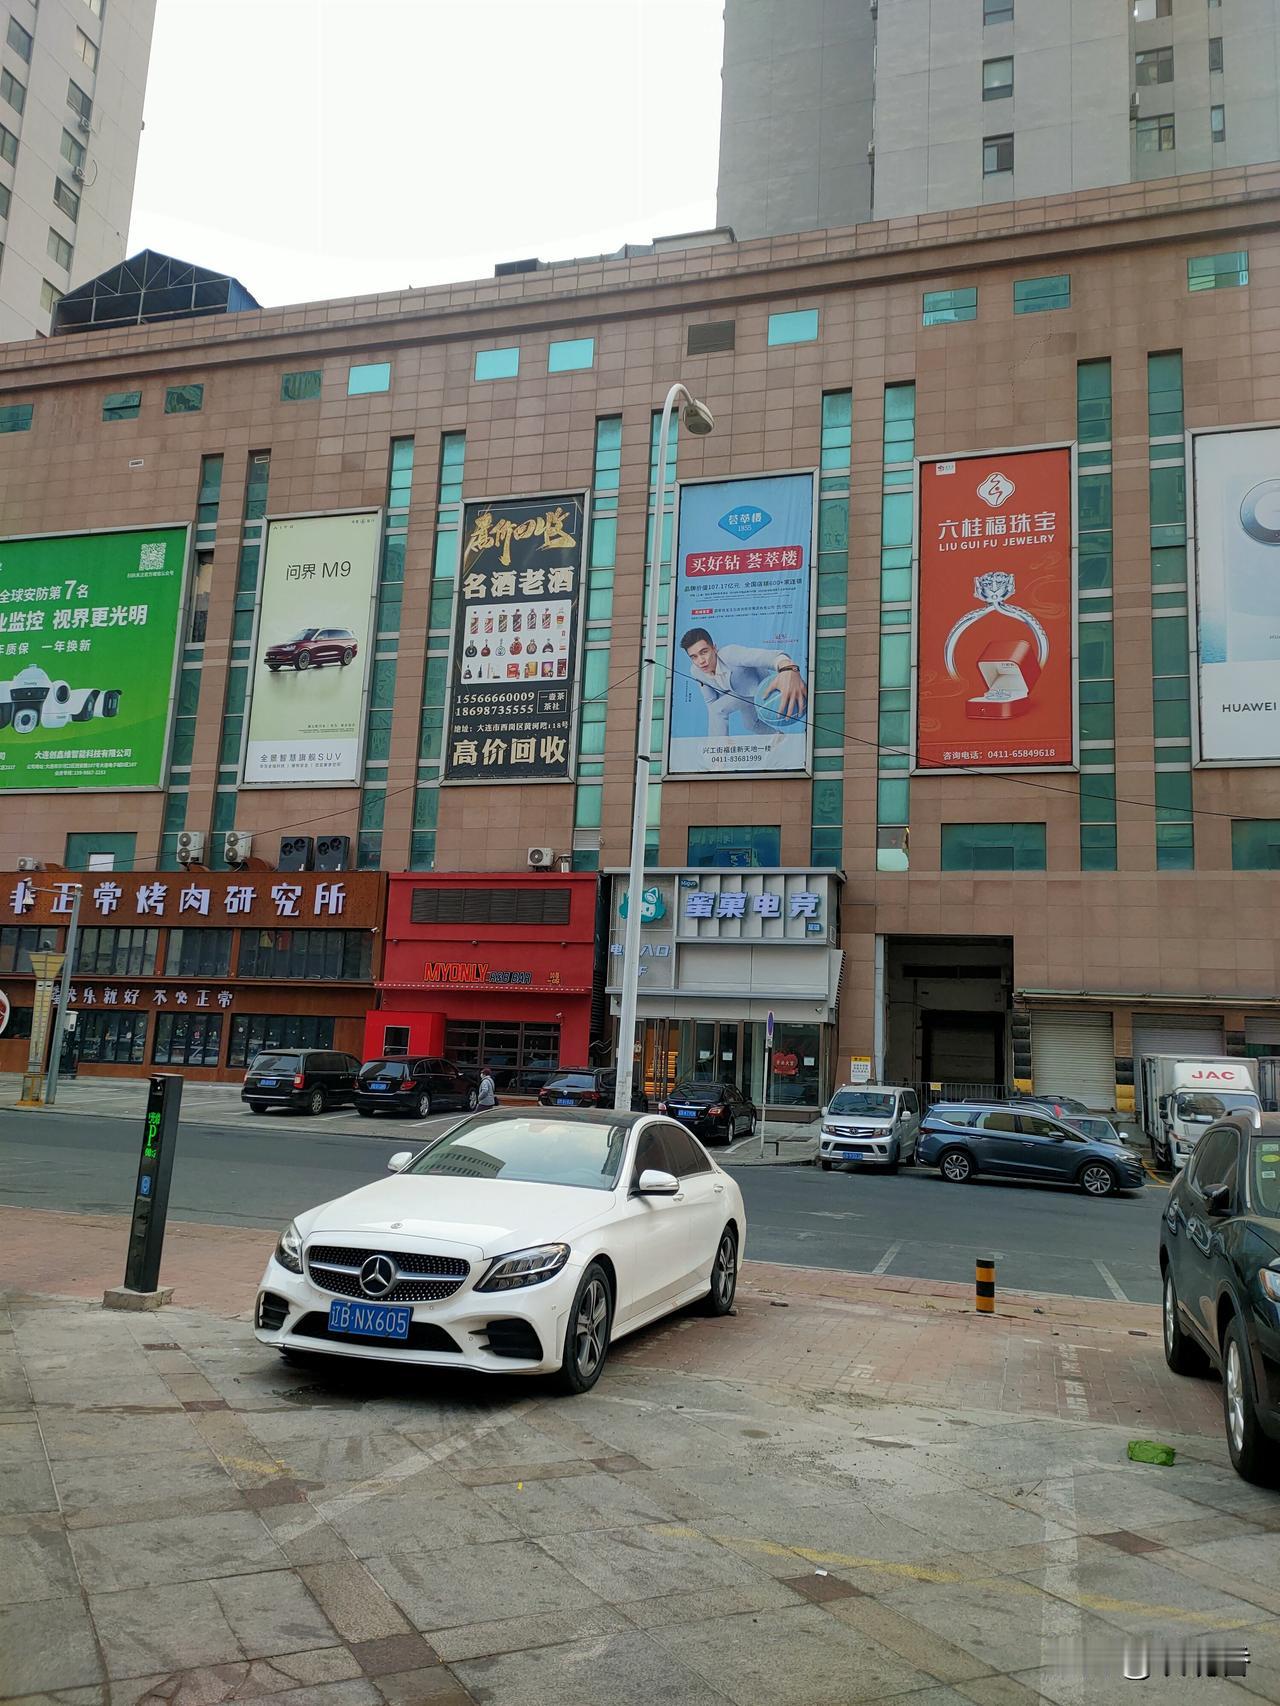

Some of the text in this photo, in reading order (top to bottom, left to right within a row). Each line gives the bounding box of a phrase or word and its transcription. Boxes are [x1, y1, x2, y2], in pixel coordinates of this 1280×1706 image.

[938, 511, 1056, 540] 六桂福珠宝
[939, 534, 1055, 551] LIU GUI FU JEWELRY
[286, 560, 352, 581] 问界 M9
[690, 550, 798, 574] 买好钻 荟萃楼
[462, 566, 576, 599] 名酒老酒
[53, 604, 148, 630] 视界更光明
[42, 639, 91, 653] 一年换新
[456, 692, 535, 704] 15566660009
[455, 704, 534, 716] 18698735555
[1222, 702, 1277, 713] HUAWEI
[453, 735, 567, 766] 高价回收
[711, 755, 762, 763] 0411-83681999
[153, 989, 233, 1008] 不必正常
[1191, 1070, 1235, 1080] JAC
